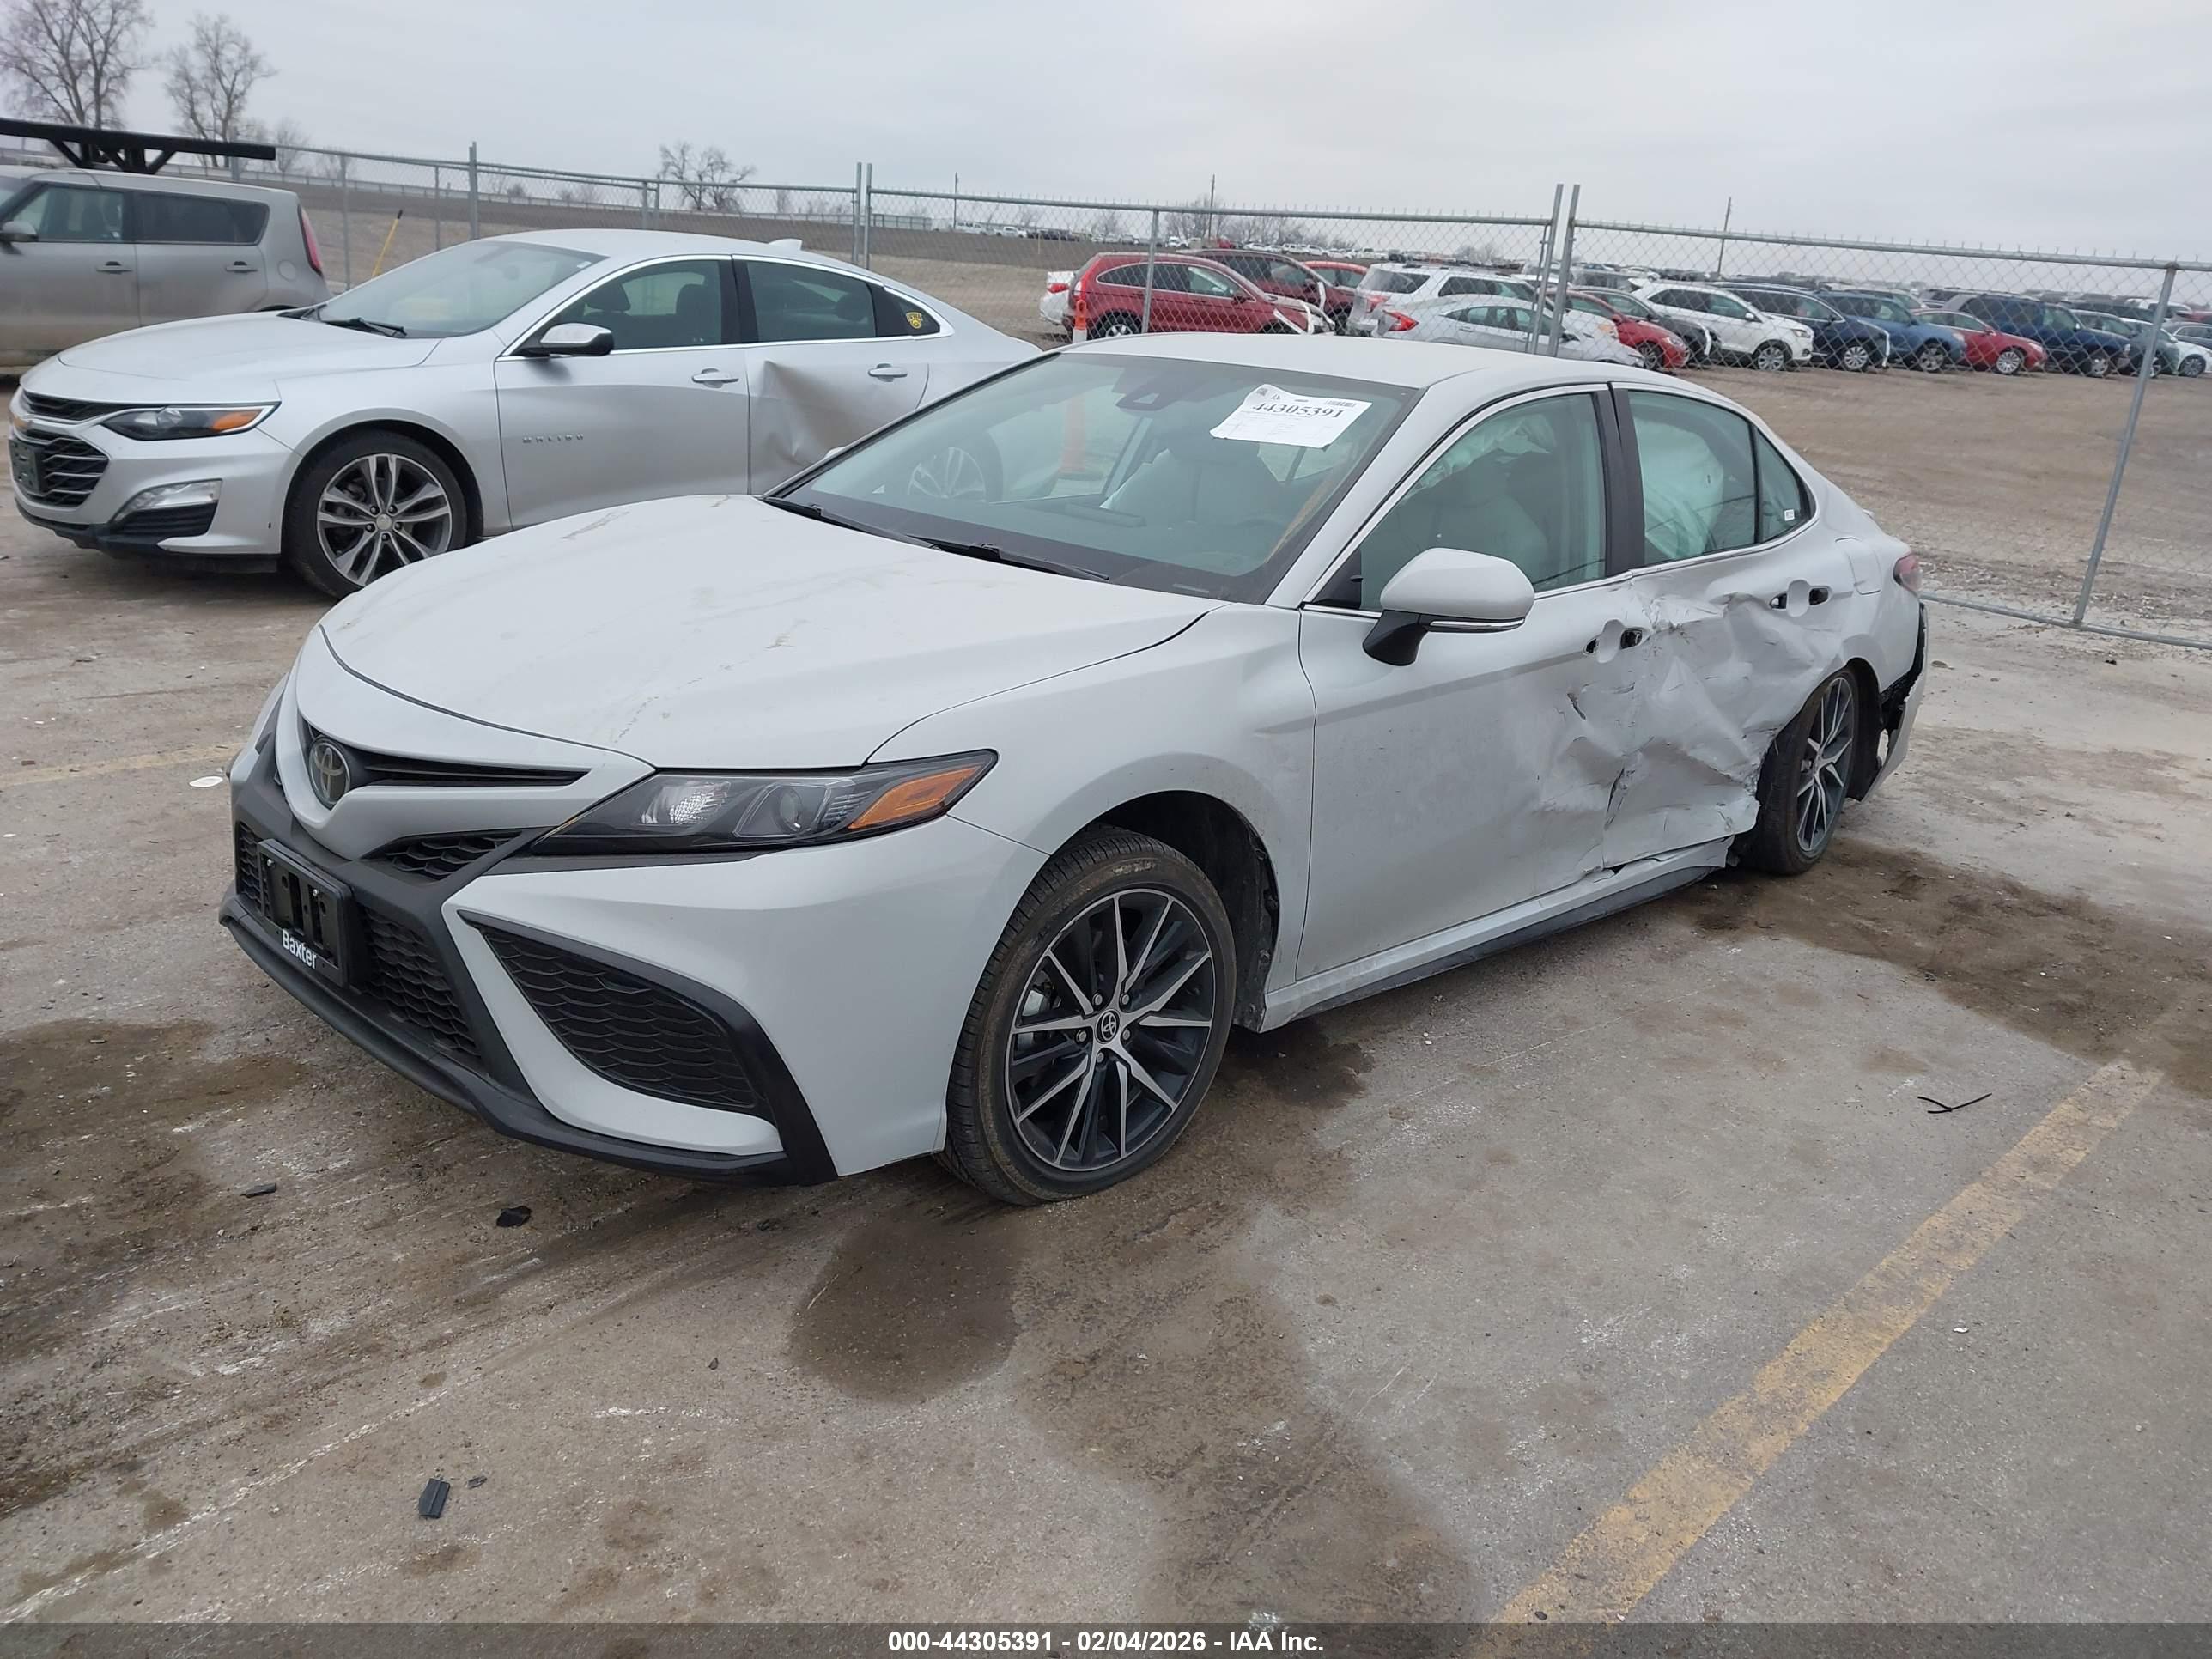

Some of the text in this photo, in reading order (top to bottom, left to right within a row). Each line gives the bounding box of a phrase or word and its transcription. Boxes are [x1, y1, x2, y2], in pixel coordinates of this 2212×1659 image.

[1253, 403, 1345, 418] 44305391
[522, 433, 584, 443] MALIBU
[282, 928, 317, 969] Baxter
